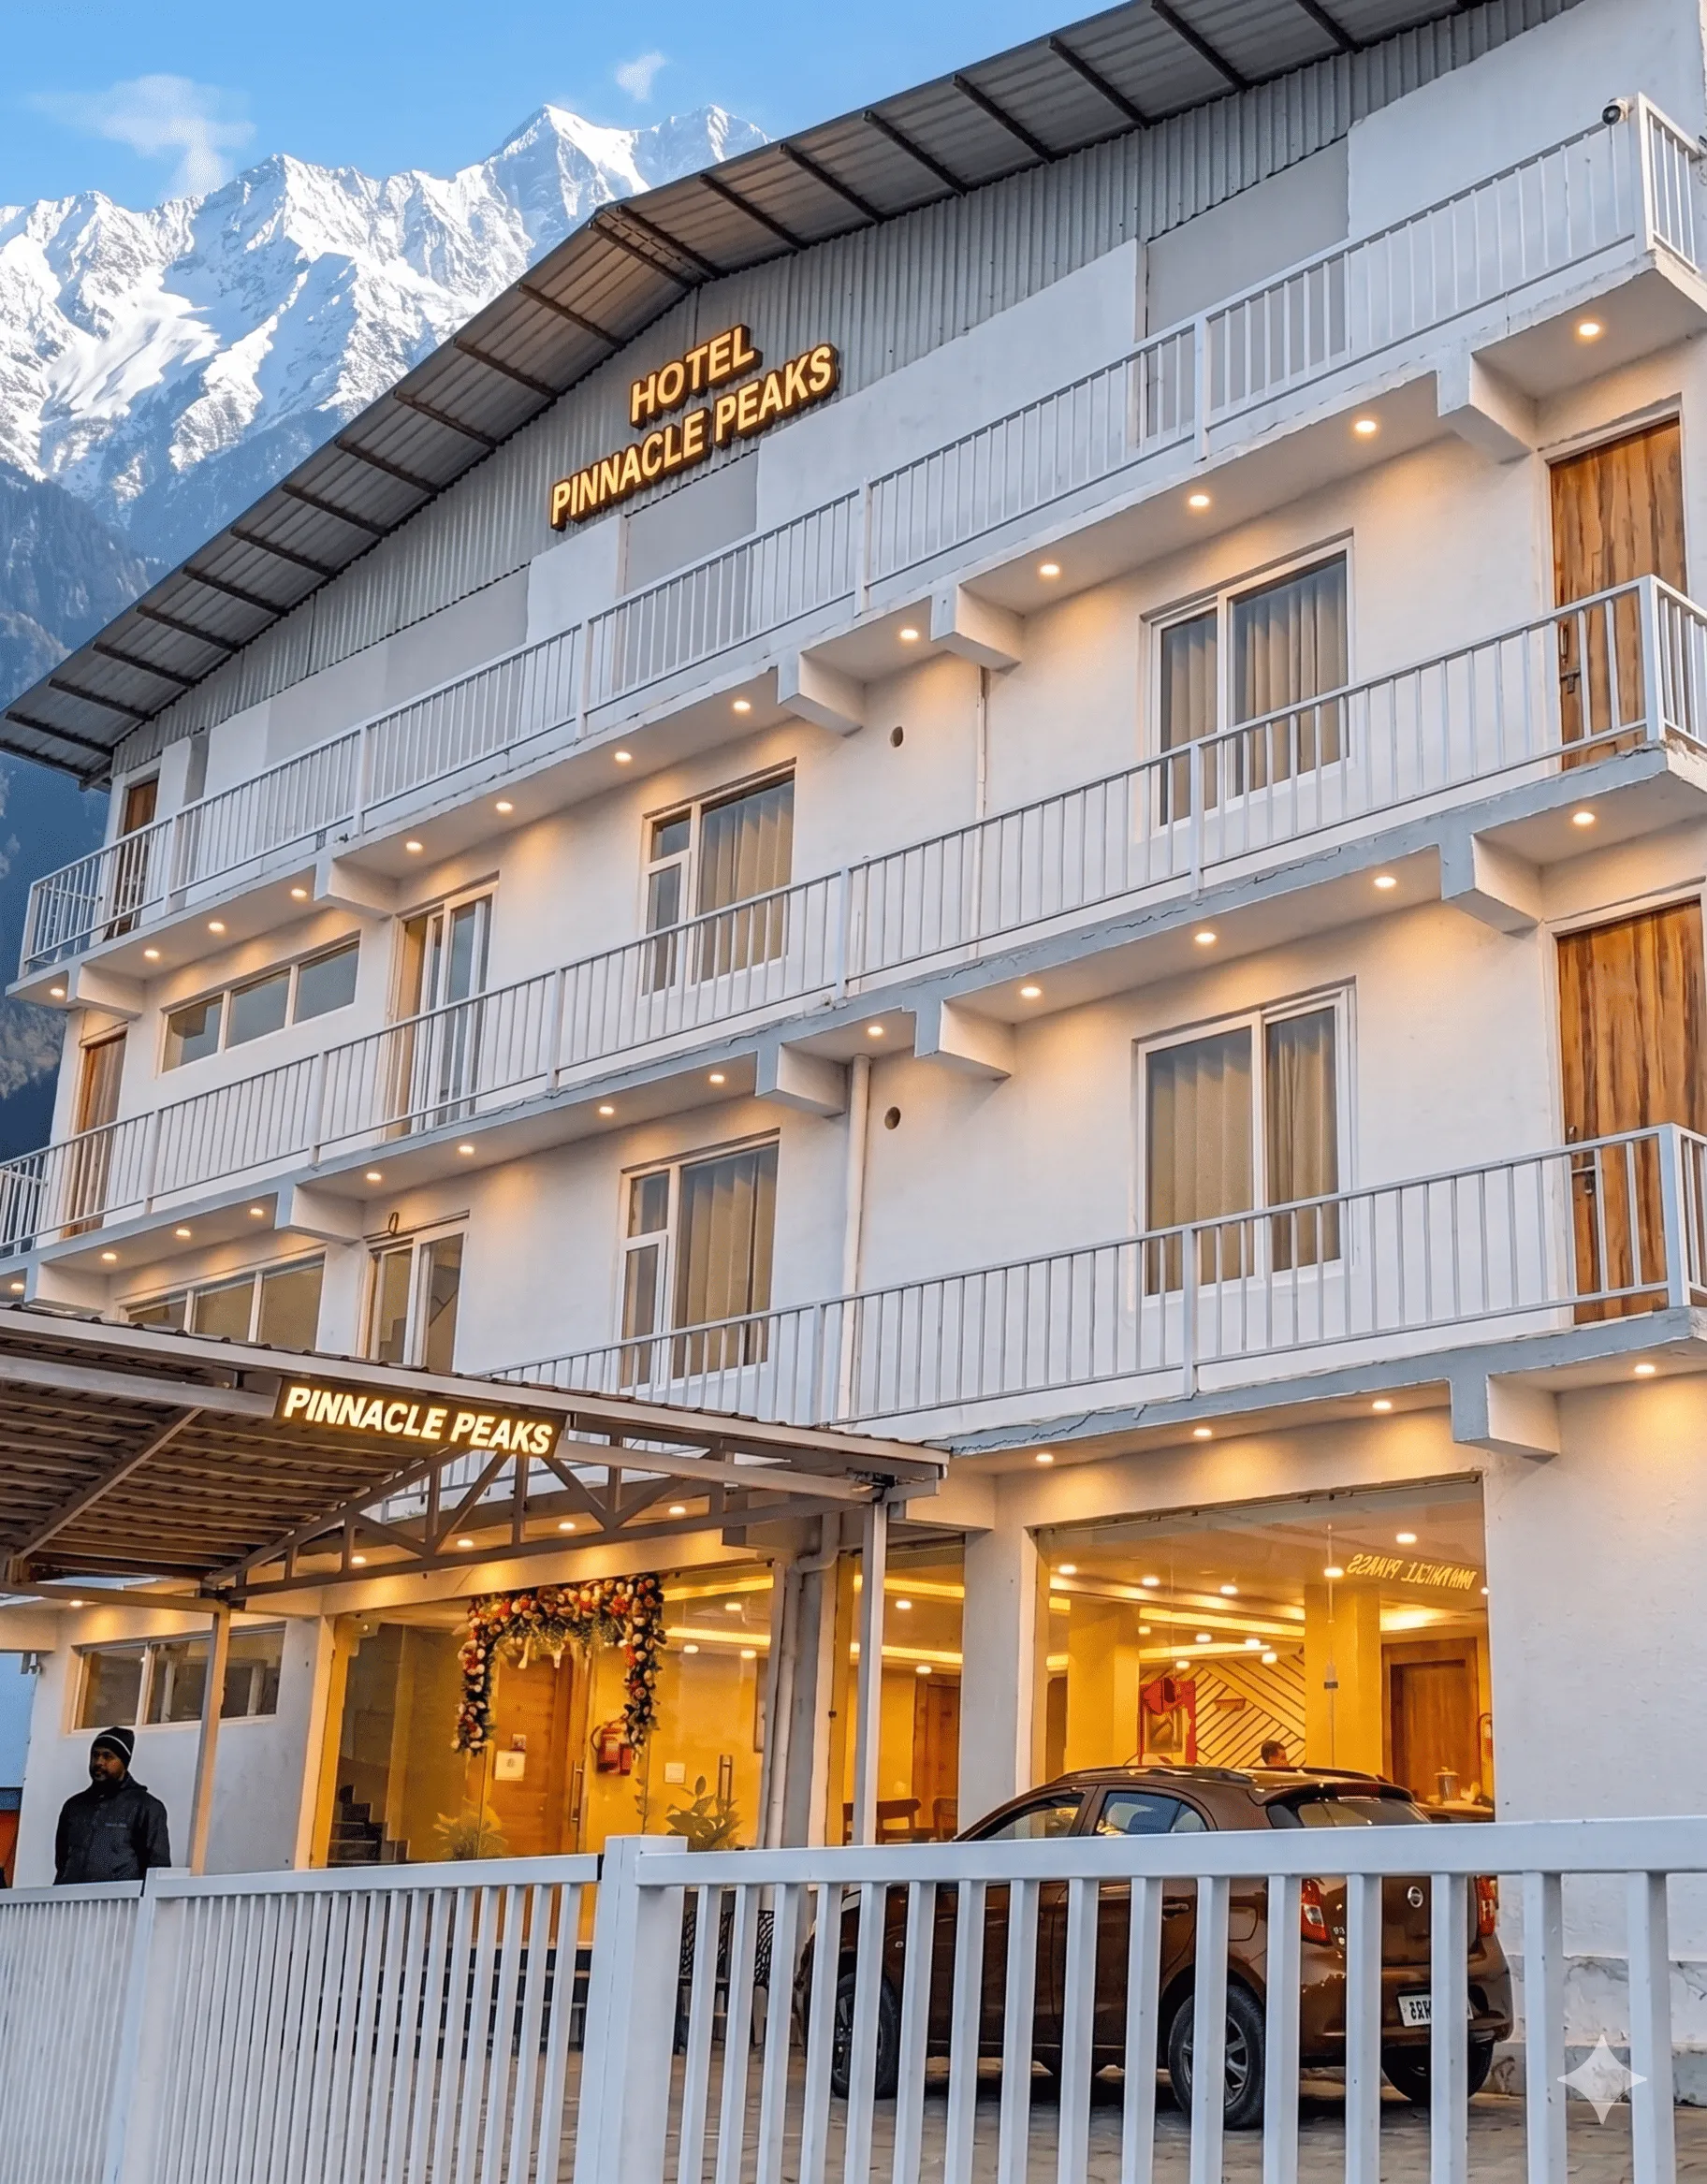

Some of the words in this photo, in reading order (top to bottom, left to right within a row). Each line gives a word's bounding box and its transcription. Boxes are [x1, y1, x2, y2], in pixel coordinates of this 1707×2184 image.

[630, 324, 760, 427] HOTEL
[550, 408, 709, 529] PINNACLE
[713, 343, 838, 447] PEAKS
[284, 1386, 448, 1440] PINNACLE
[449, 1412, 553, 1454] PEAKS
